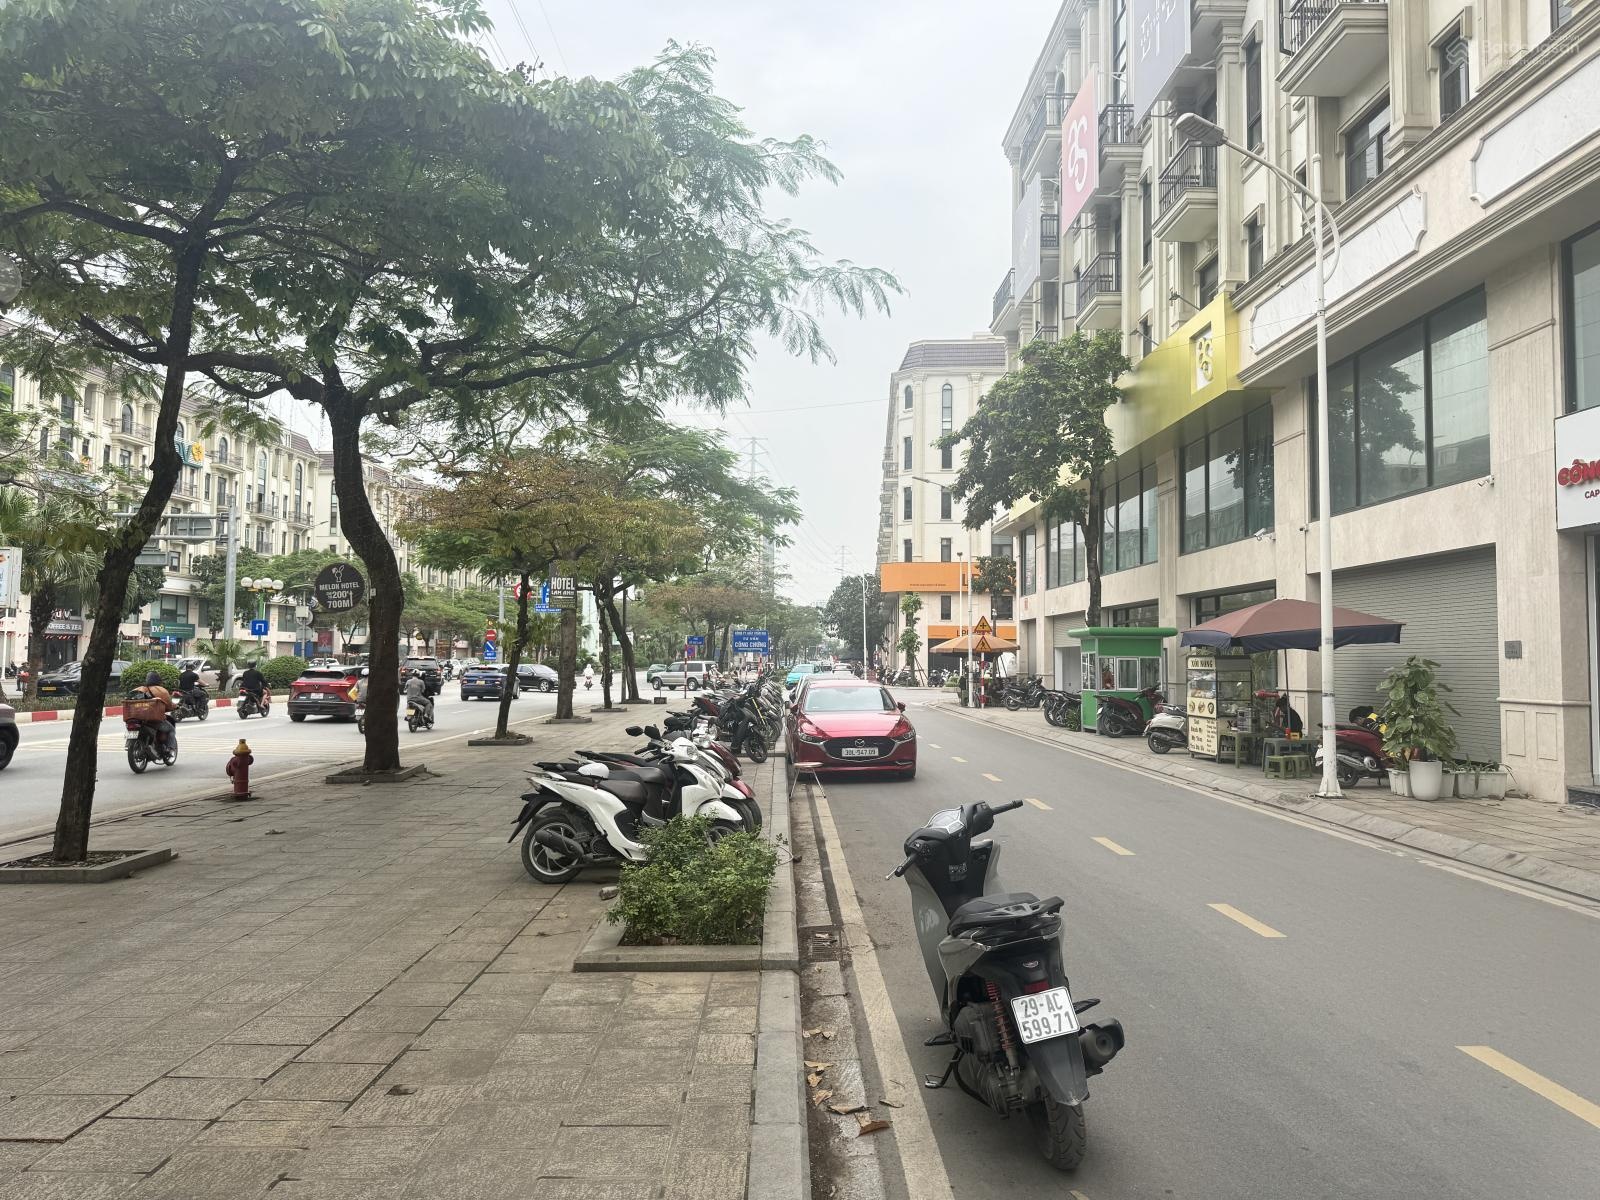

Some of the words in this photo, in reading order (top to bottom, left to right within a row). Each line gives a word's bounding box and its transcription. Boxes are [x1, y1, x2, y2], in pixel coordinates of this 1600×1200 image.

[341, 581, 360, 590] HOTEL
[551, 577, 575, 590] HOTEL
[1021, 993, 1063, 1018] 29-AC
[1022, 1011, 1074, 1039] 599.71
